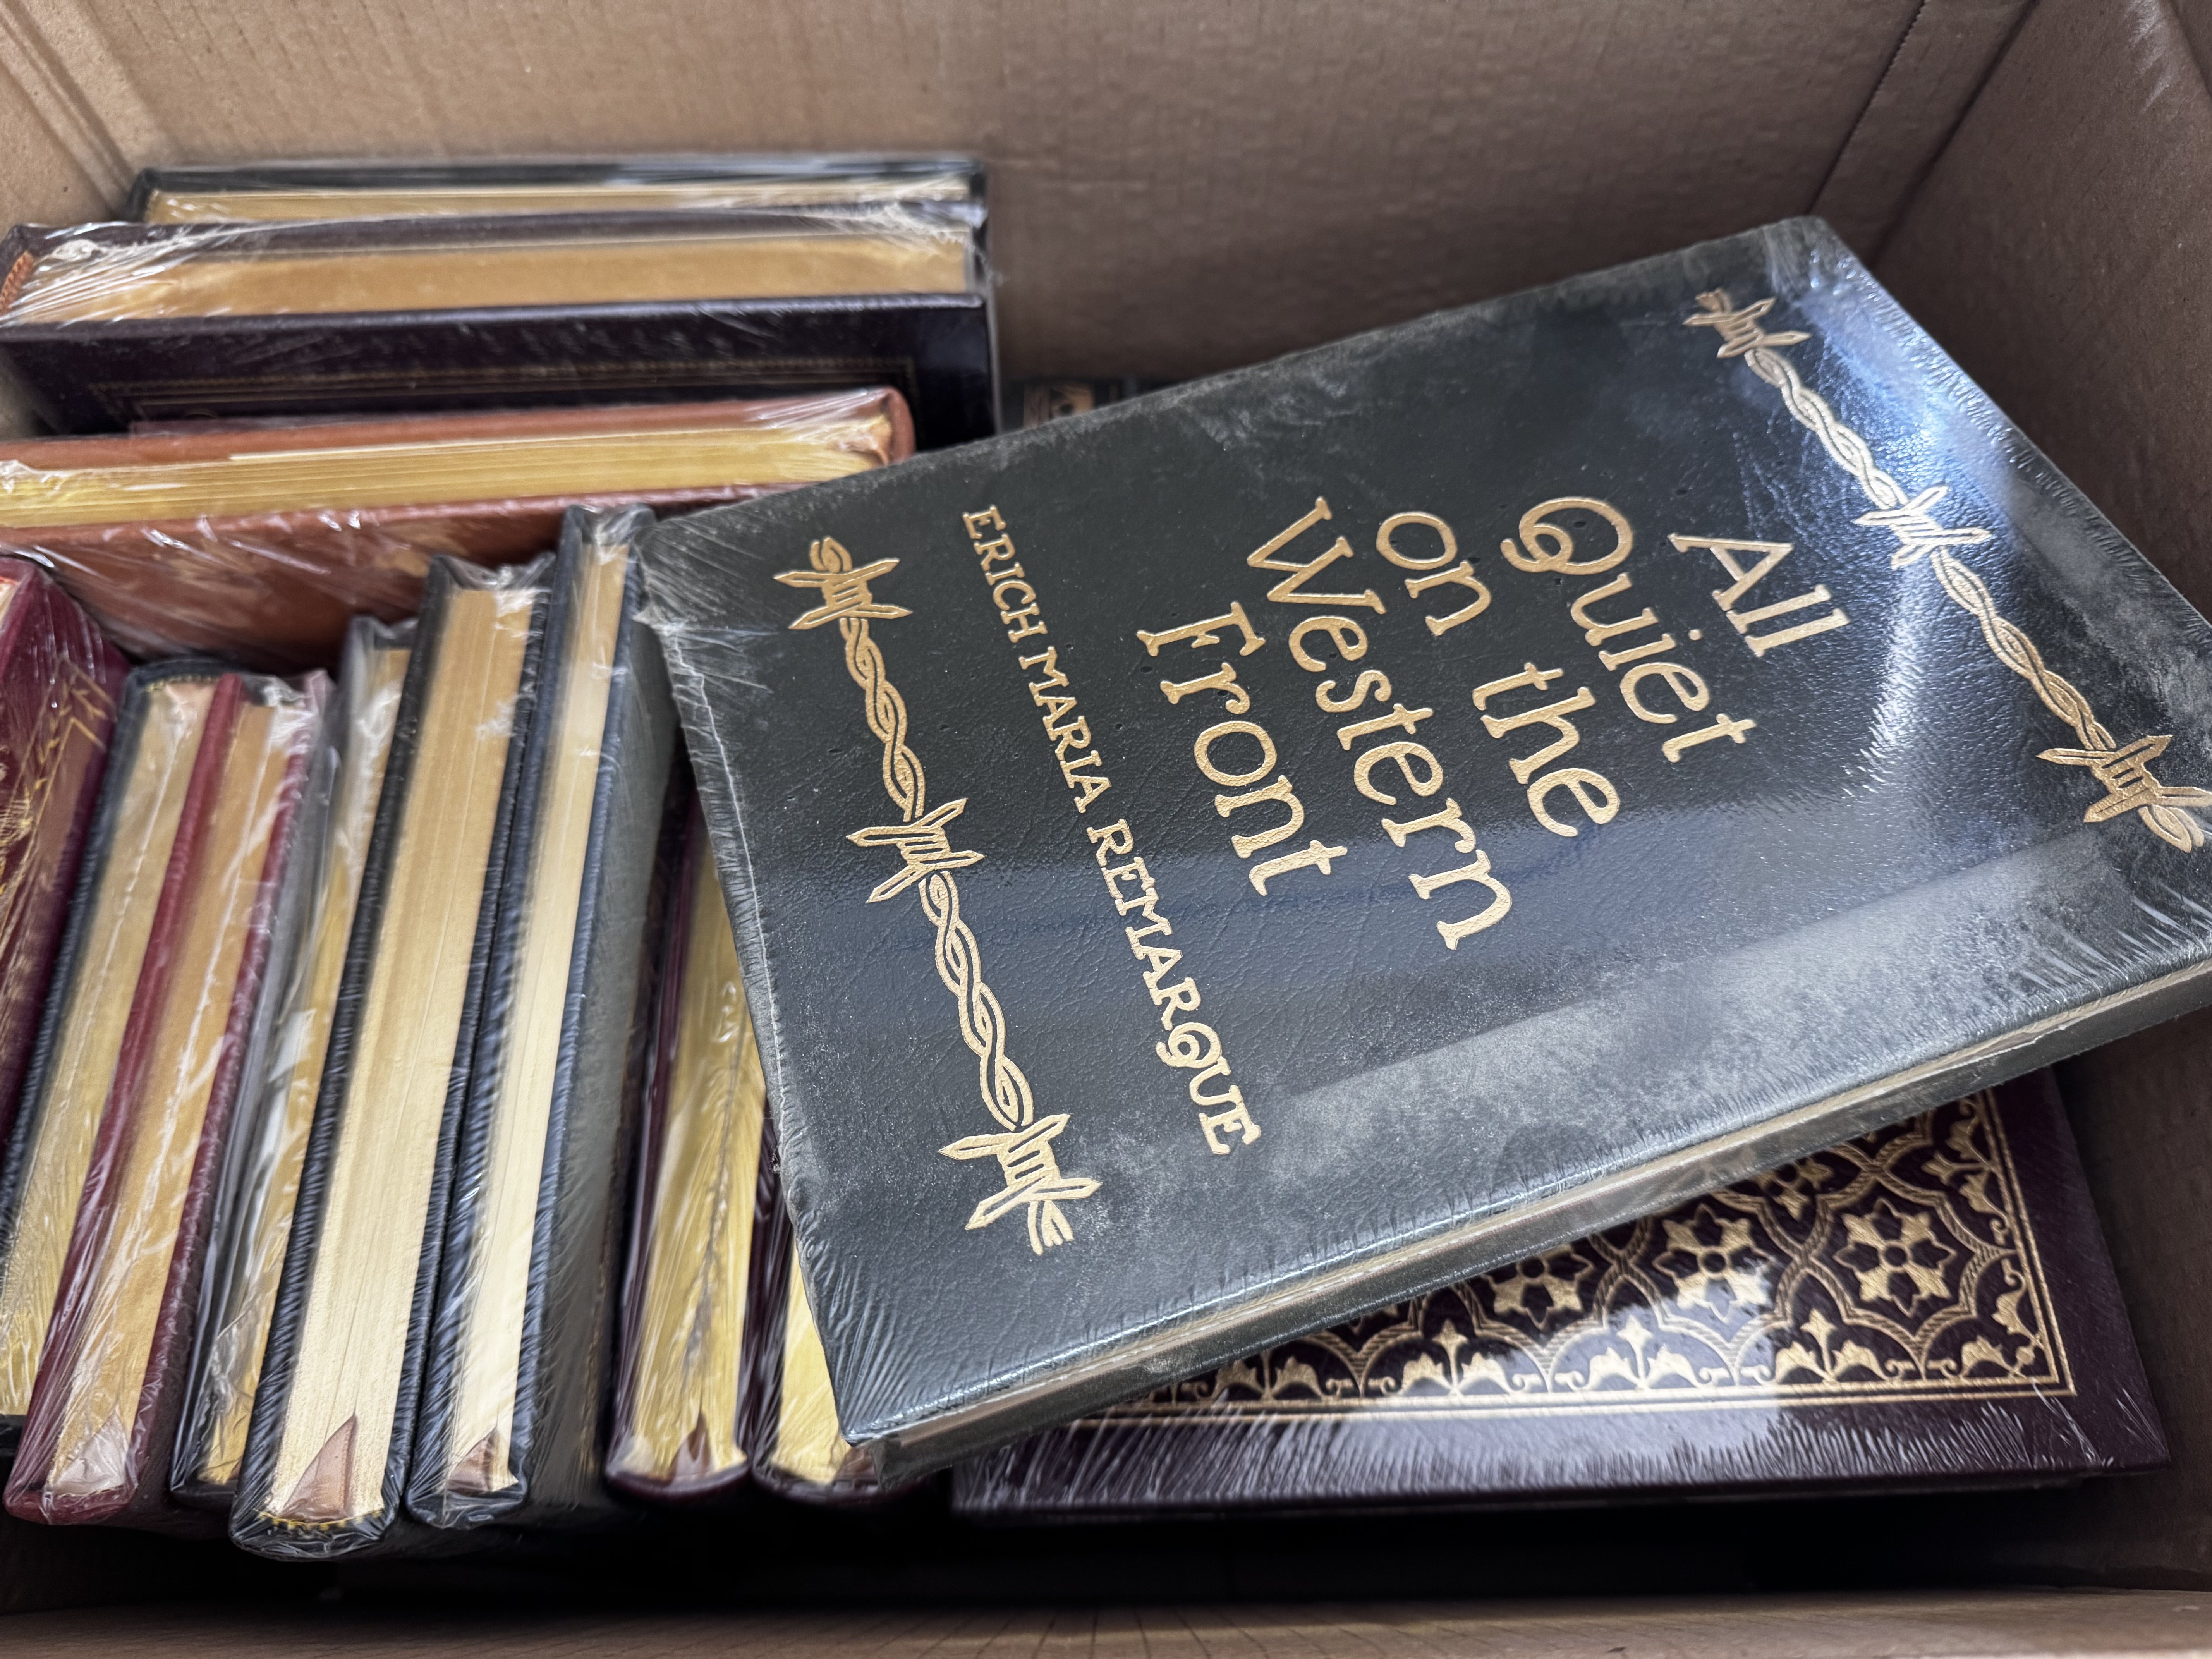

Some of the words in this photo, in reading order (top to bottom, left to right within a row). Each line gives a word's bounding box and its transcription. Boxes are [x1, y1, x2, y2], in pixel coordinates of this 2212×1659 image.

[1136, 601, 1348, 897] Front
[1247, 496, 1513, 951] Western
[1375, 511, 1491, 636] on
[1472, 662, 1620, 837] the
[1500, 496, 1757, 763] Quiet
[1667, 532, 1850, 657] All
[962, 505, 1048, 643] ERICH
[1018, 646, 1113, 813] MARIA
[1086, 818, 1261, 1154] REMARQUE
